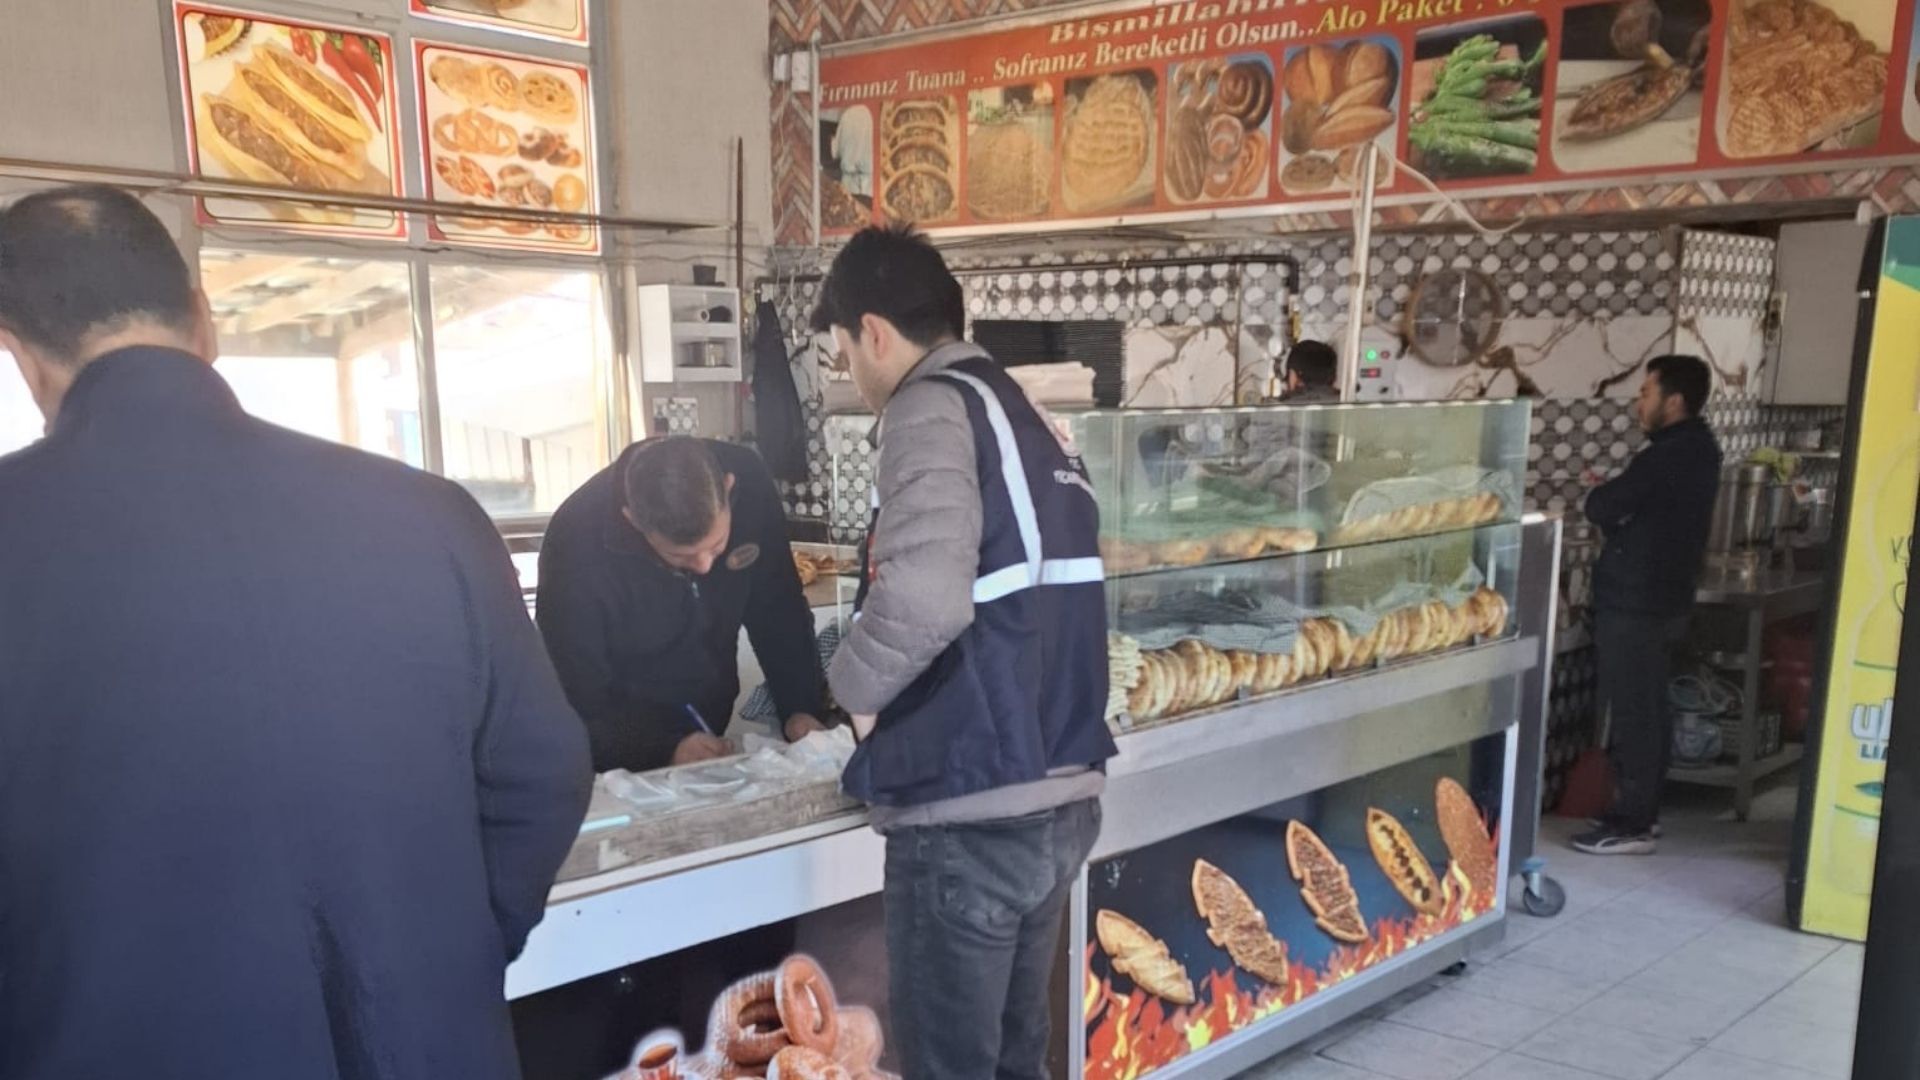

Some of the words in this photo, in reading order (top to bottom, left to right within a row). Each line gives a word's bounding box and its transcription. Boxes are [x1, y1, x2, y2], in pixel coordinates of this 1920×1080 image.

[906, 69, 966, 92] Tuana
[993, 50, 1088, 81] Sofranız
[1094, 27, 1208, 67] Bereketli
[1376, 0, 1463, 25] Paket
